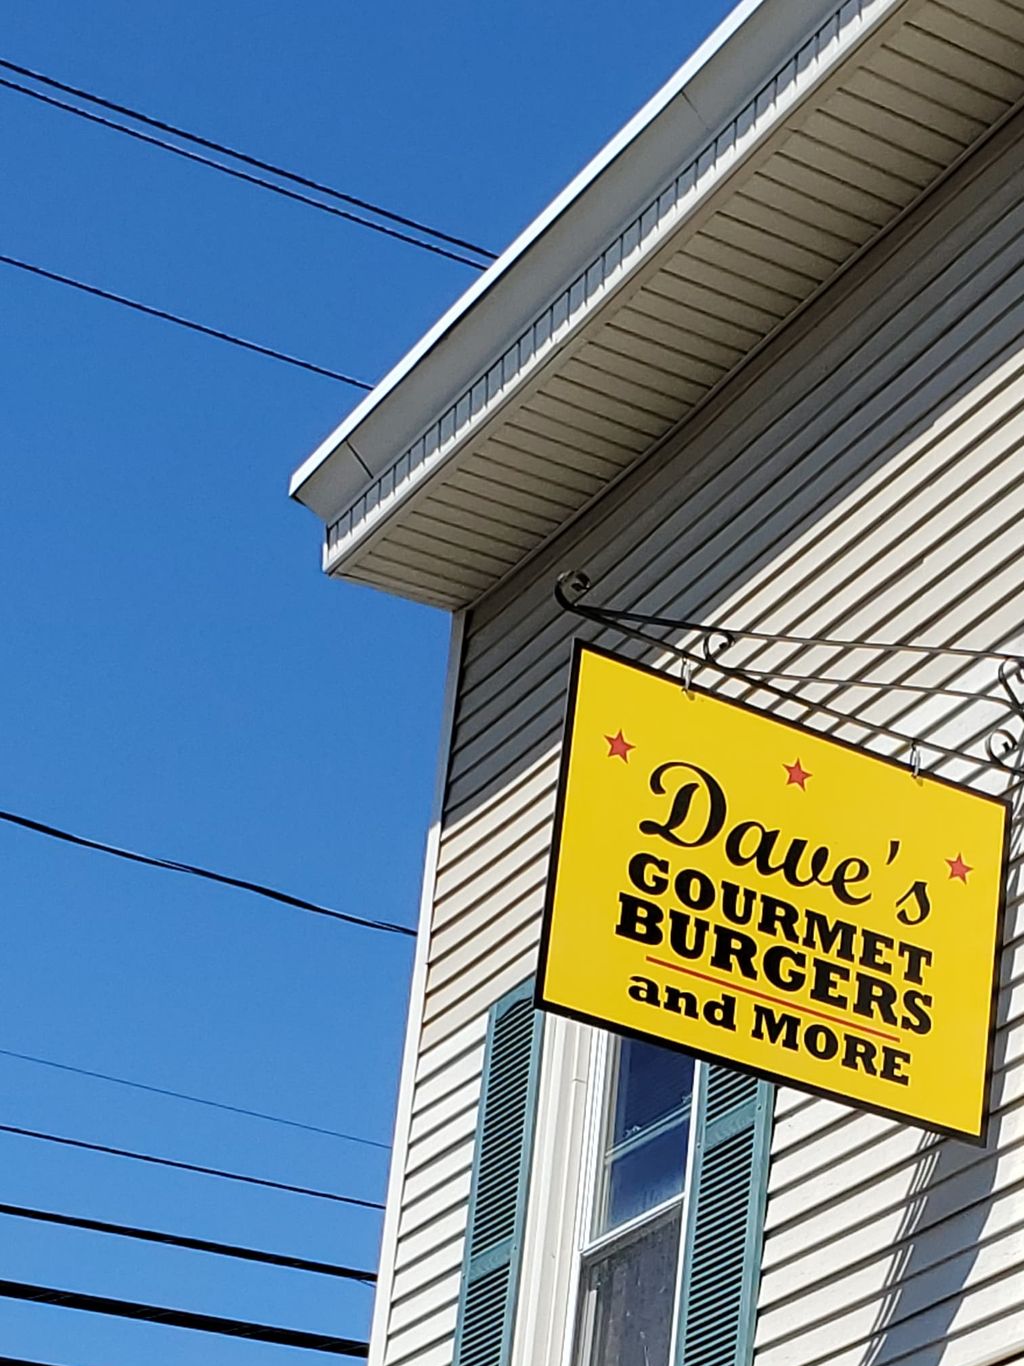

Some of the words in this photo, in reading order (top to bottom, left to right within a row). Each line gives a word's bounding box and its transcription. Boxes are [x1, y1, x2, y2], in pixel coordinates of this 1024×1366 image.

[638, 761, 931, 926] Dave's
[615, 892, 933, 1035] BURGERS
[628, 852, 933, 983] GOURMET
[628, 975, 737, 1032] and
[751, 1004, 911, 1086] MORE
